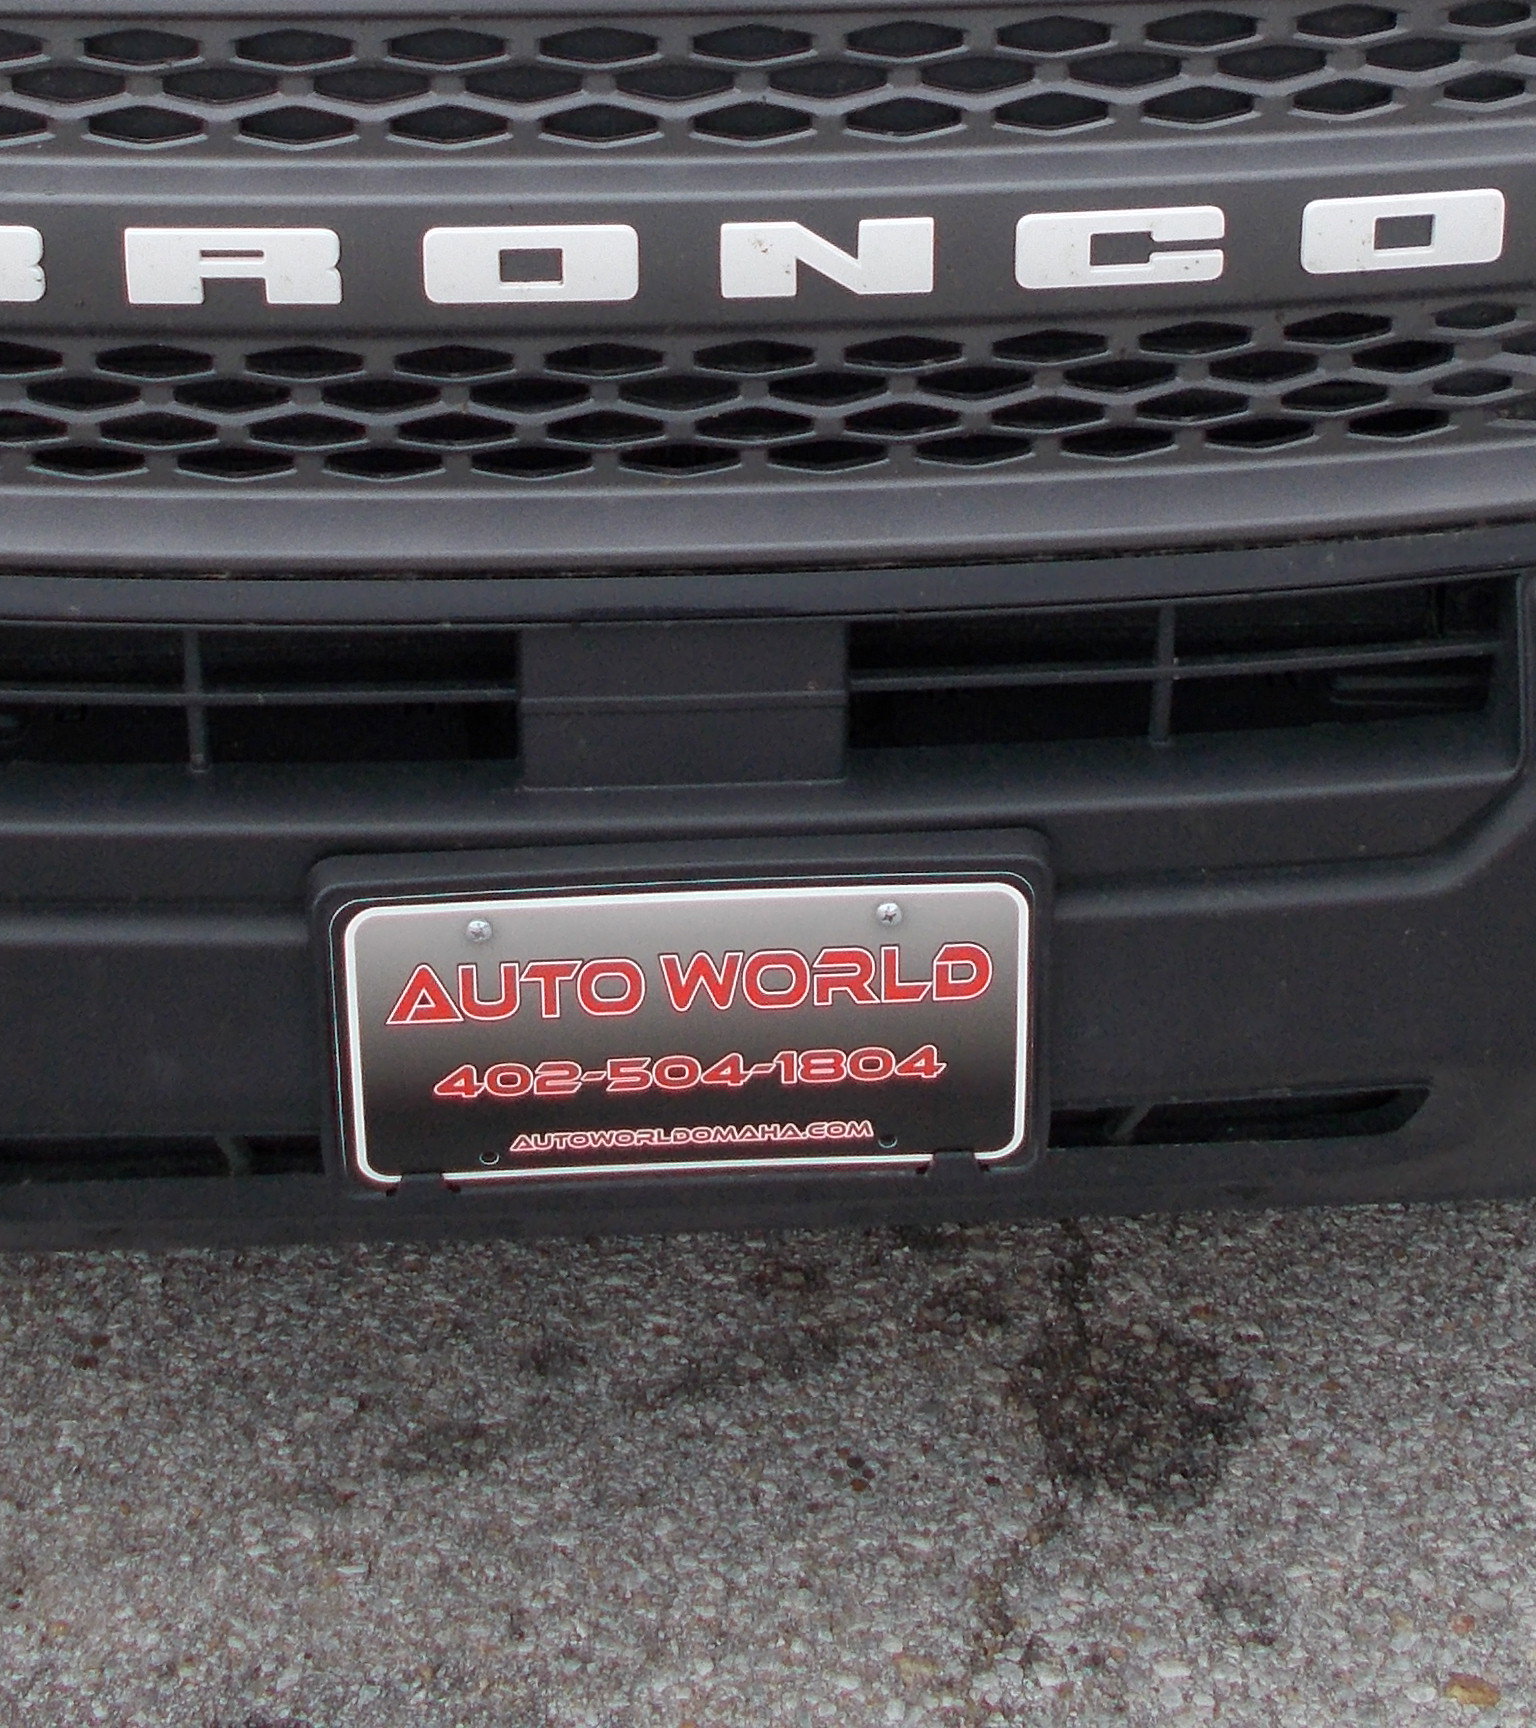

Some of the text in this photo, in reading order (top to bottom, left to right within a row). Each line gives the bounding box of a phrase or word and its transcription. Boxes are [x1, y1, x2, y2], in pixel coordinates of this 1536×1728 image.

[385, 942, 994, 1025] AUTO WORLD
[433, 1044, 948, 1099] 402-504-1804
[510, 1120, 874, 1153] AUTOWORLDOMAHA.COM
